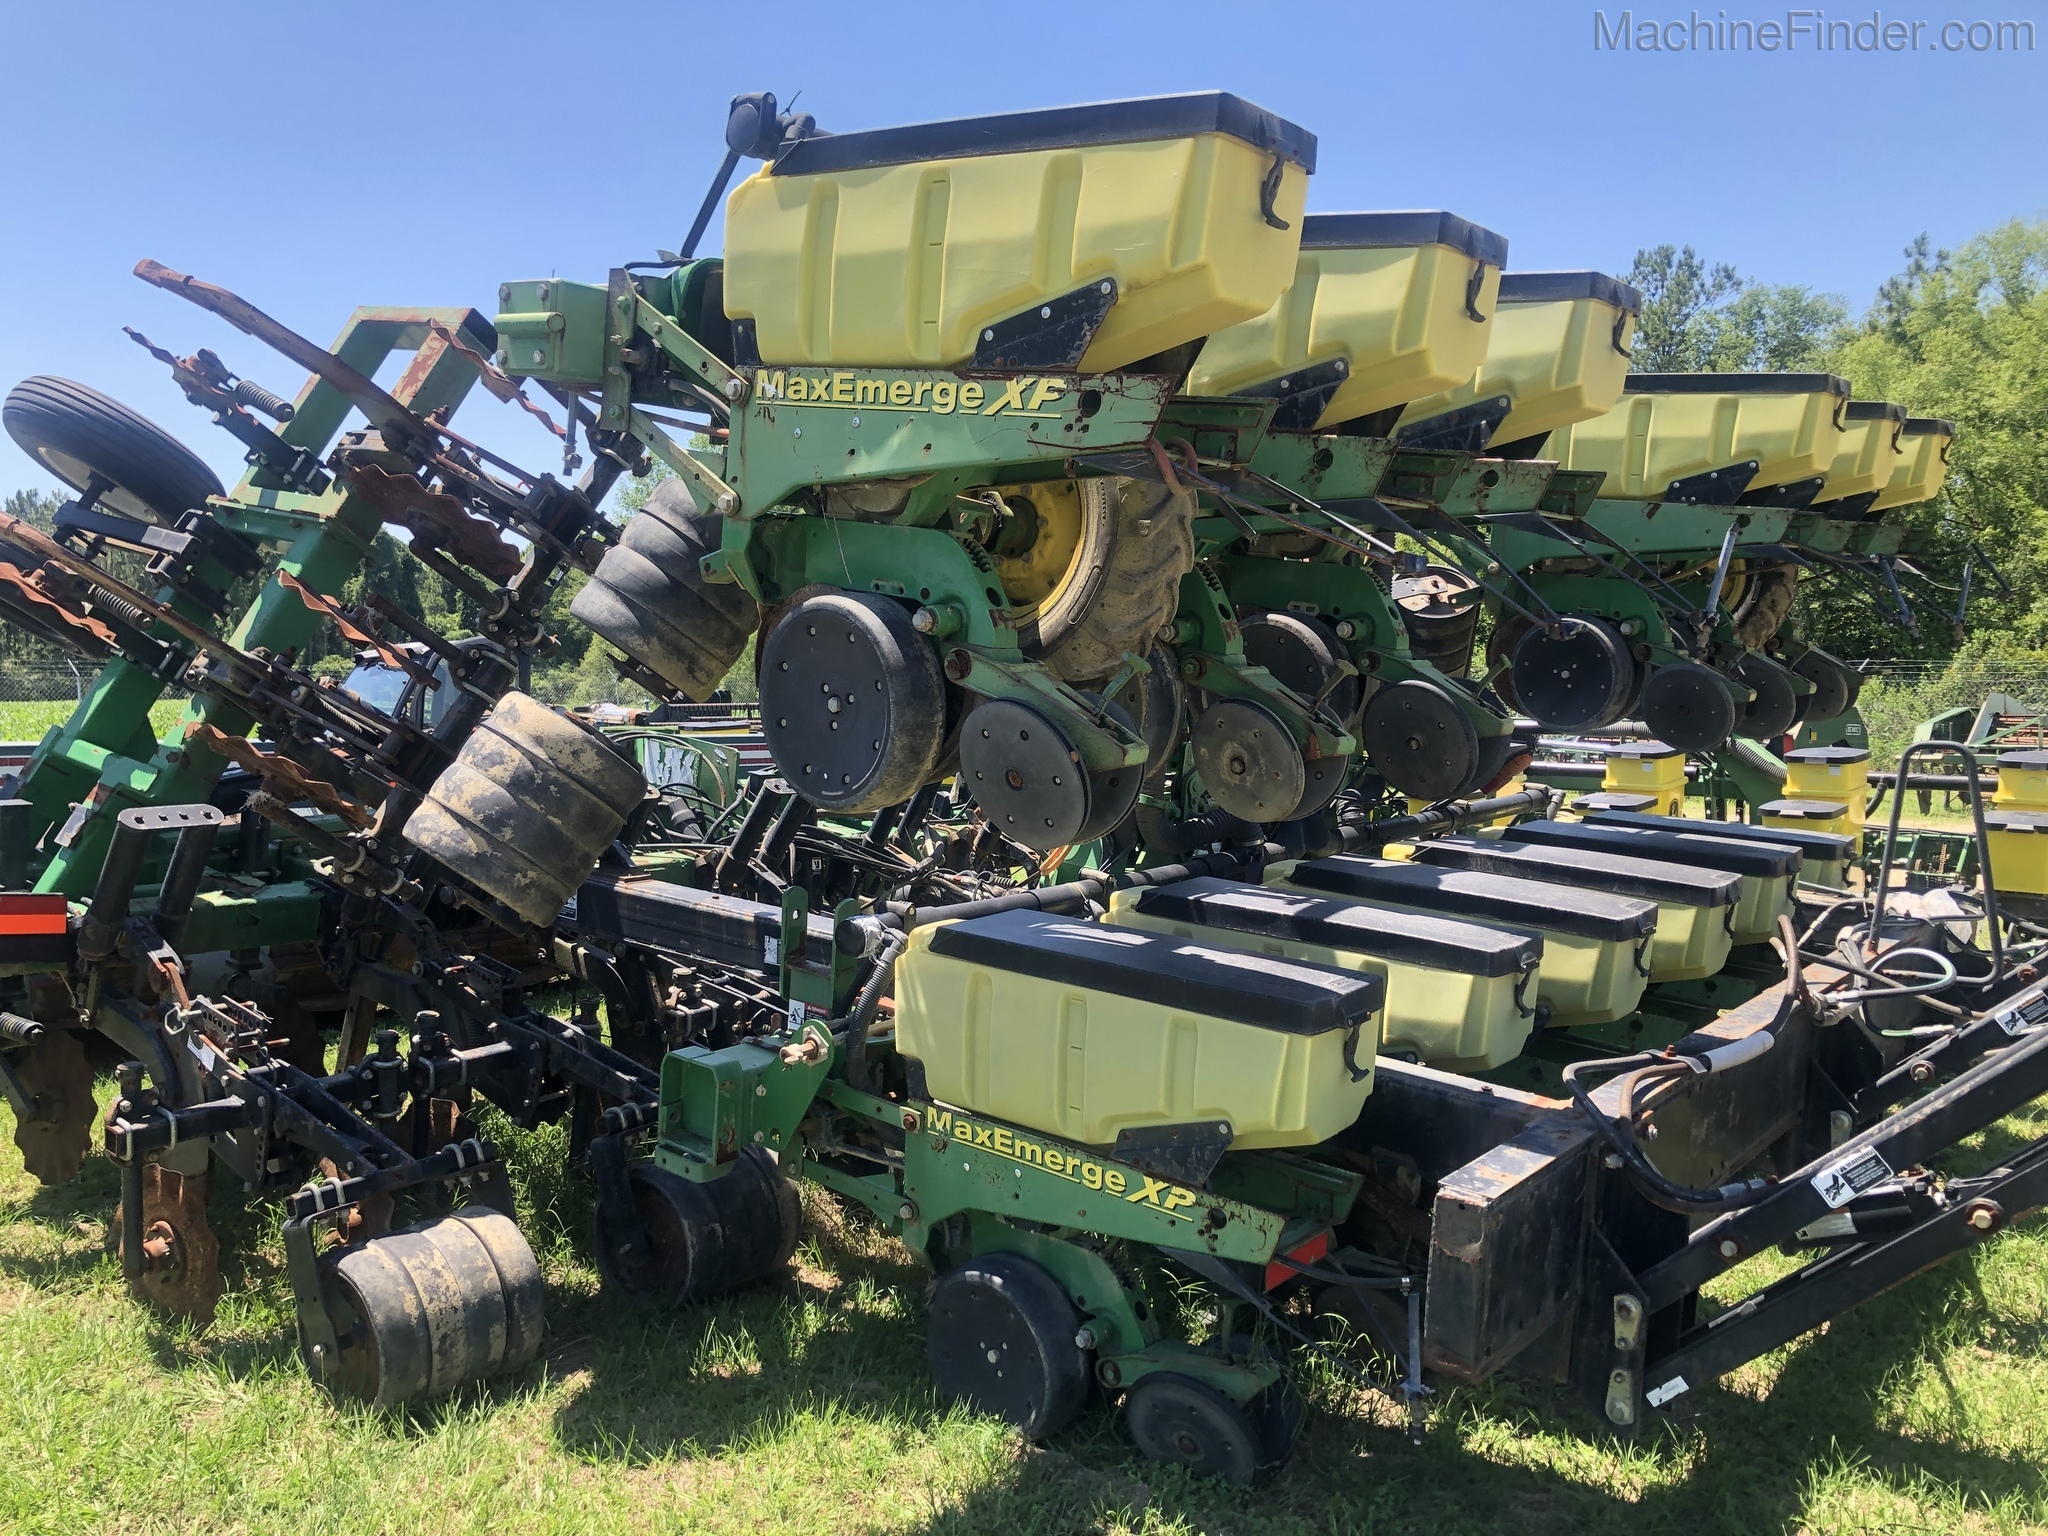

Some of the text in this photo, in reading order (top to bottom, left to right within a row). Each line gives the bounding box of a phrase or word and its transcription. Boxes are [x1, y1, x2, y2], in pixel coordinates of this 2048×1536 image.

[755, 369, 1068, 416] MaxEmerge XP
[927, 1105, 1198, 1211] MaxEmerge XP
[1845, 1149, 1874, 1168] WARNING
